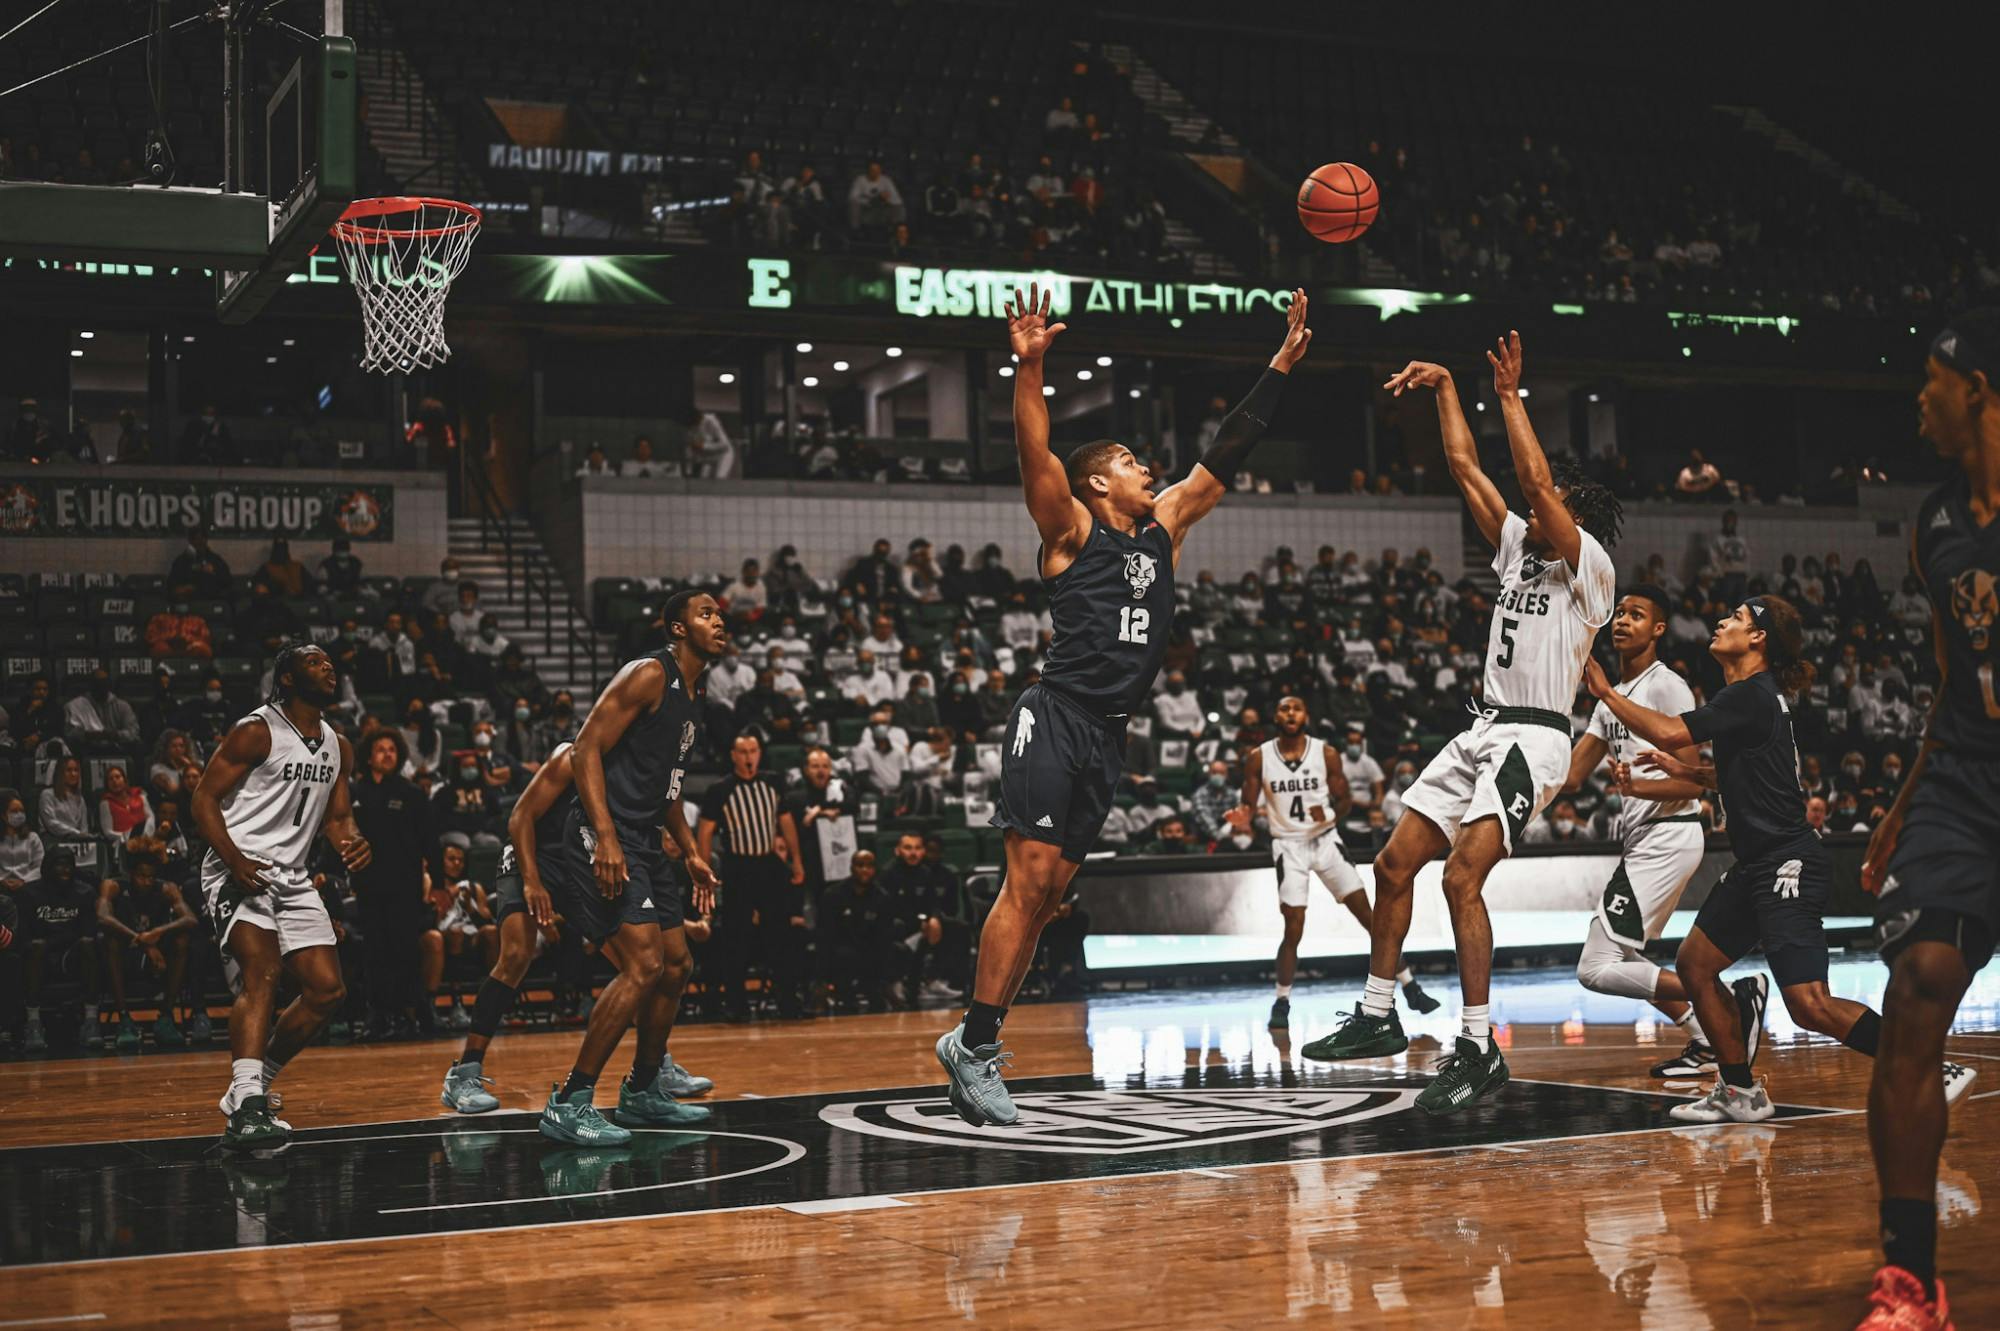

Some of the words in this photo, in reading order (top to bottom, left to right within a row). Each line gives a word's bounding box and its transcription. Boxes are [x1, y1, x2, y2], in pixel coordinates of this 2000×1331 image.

[747, 258, 791, 308] E
[56, 488, 77, 527] E
[90, 488, 201, 528] HOOPS
[213, 490, 323, 530] GROUP
[1118, 605, 1150, 644] 12
[1497, 617, 1519, 669] 5
[283, 763, 334, 783] EAGLES
[666, 768, 686, 800] 15
[1270, 777, 1319, 794] EAGLES
[292, 787, 310, 827] 1
[1289, 795, 1305, 822] 4
[1507, 792, 1529, 820] E
[218, 900, 232, 920] E
[1606, 893, 1629, 915] E
